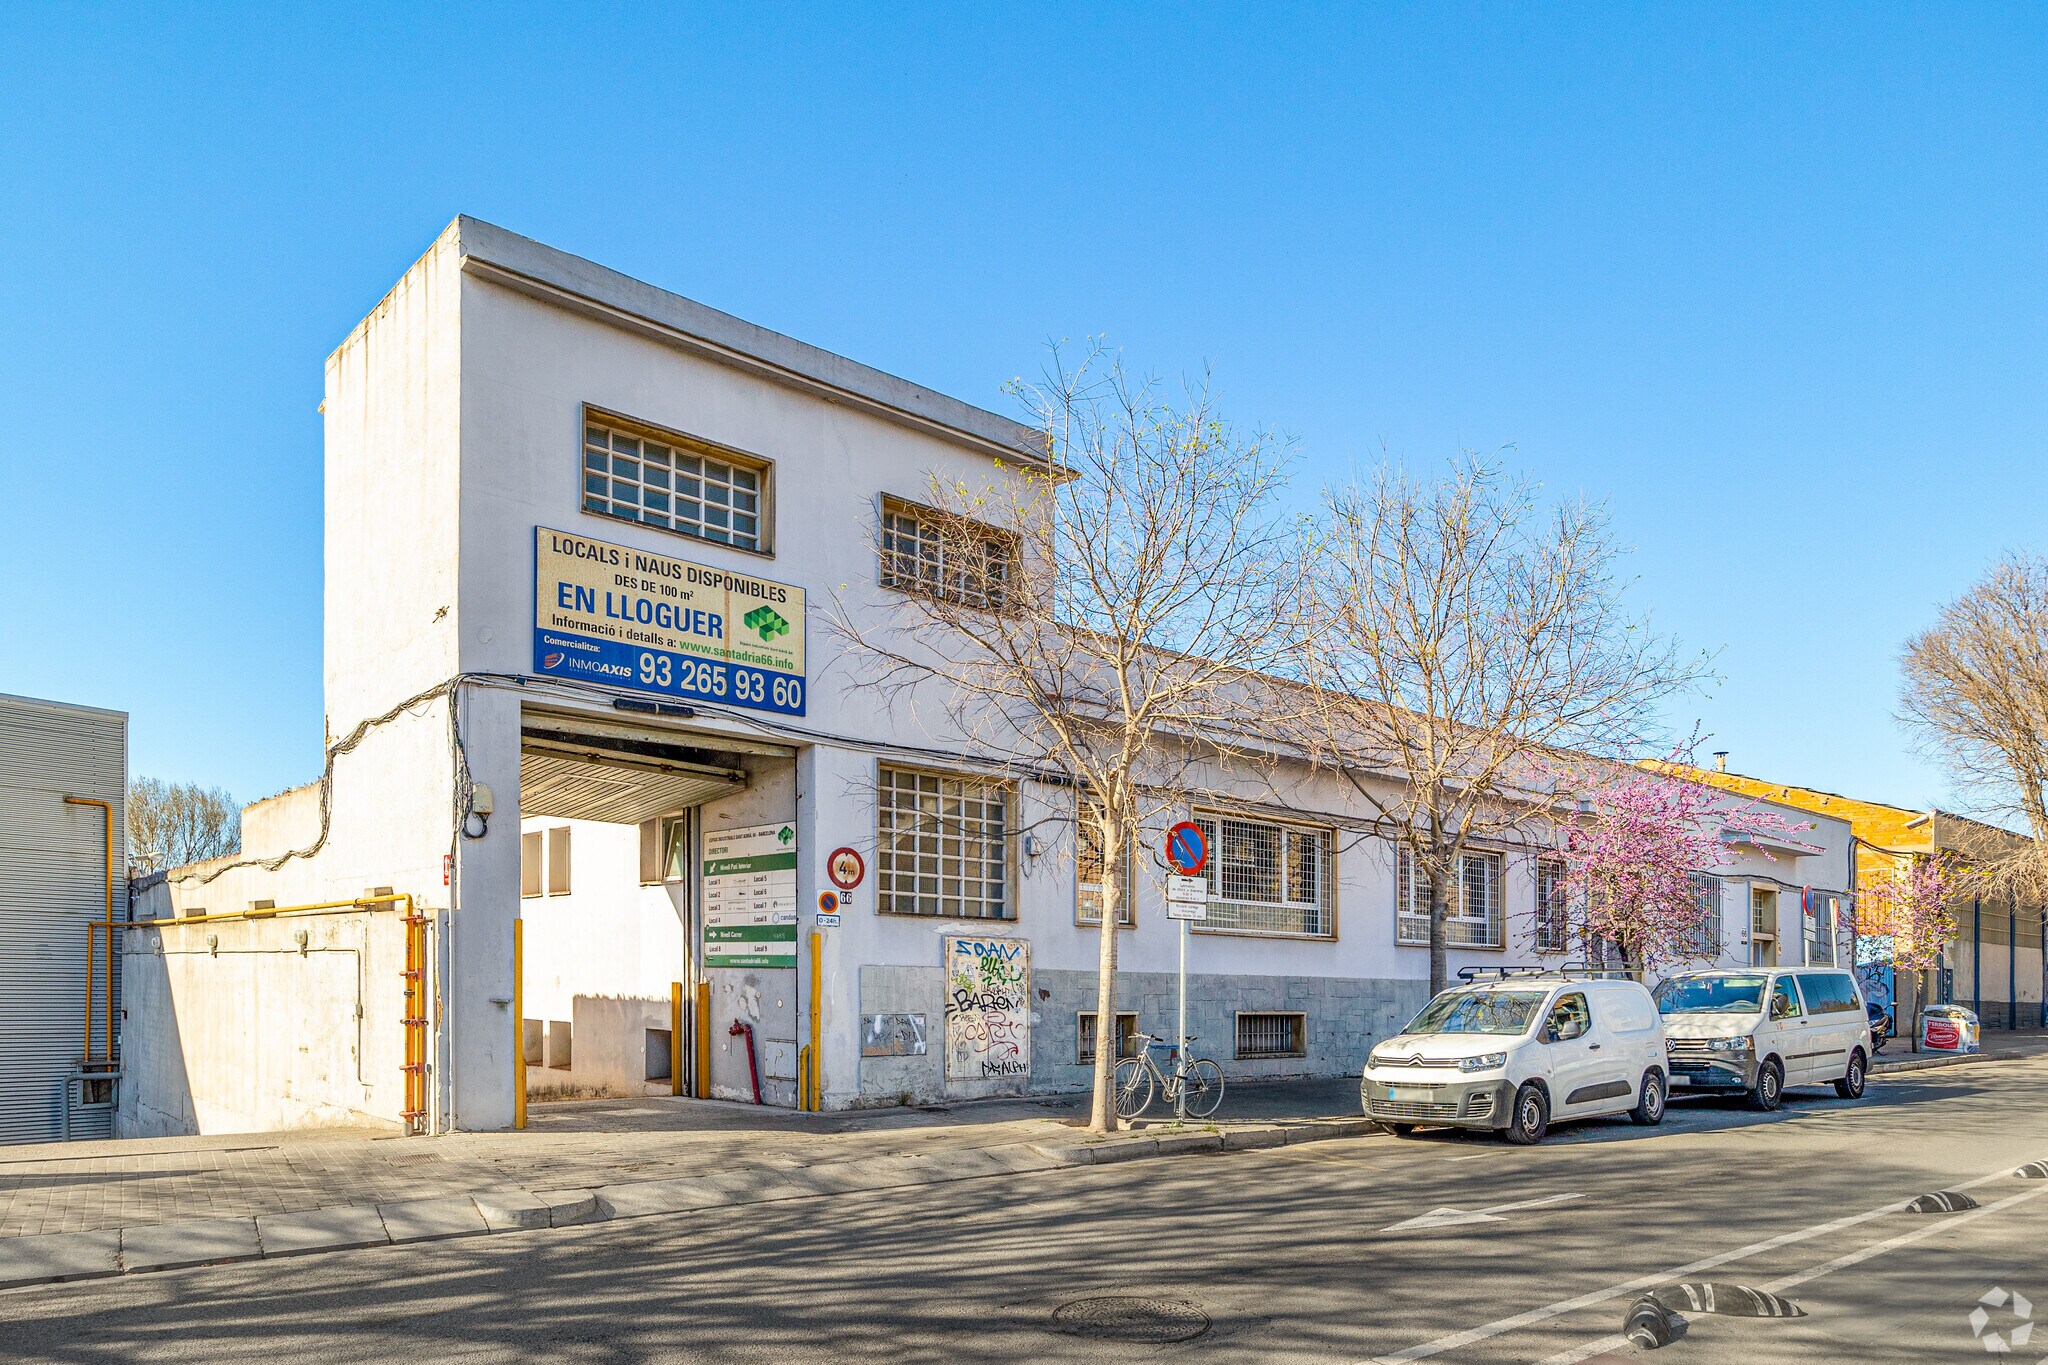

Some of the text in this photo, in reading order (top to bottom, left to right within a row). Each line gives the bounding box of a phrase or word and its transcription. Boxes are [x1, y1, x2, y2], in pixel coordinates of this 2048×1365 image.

[552, 535, 787, 603] LOCALS i NAUS DISPONIBLES
[615, 573, 638, 589] DES
[641, 579, 656, 593] DE
[660, 584, 677, 598] 100
[558, 581, 723, 639] EN LLOGUER
[544, 634, 601, 653] Comercialitza:
[552, 613, 794, 670] Informació i detalls a: www.santadria66.info
[568, 656, 632, 678] INMOAXIS
[639, 652, 802, 709] 93 265 93 60
[708, 846, 729, 855] DIRECTORI
[839, 860, 855, 876] 4 m
[753, 875, 764, 883] Local
[840, 892, 852, 904] 66
[753, 915, 764, 923] Local
